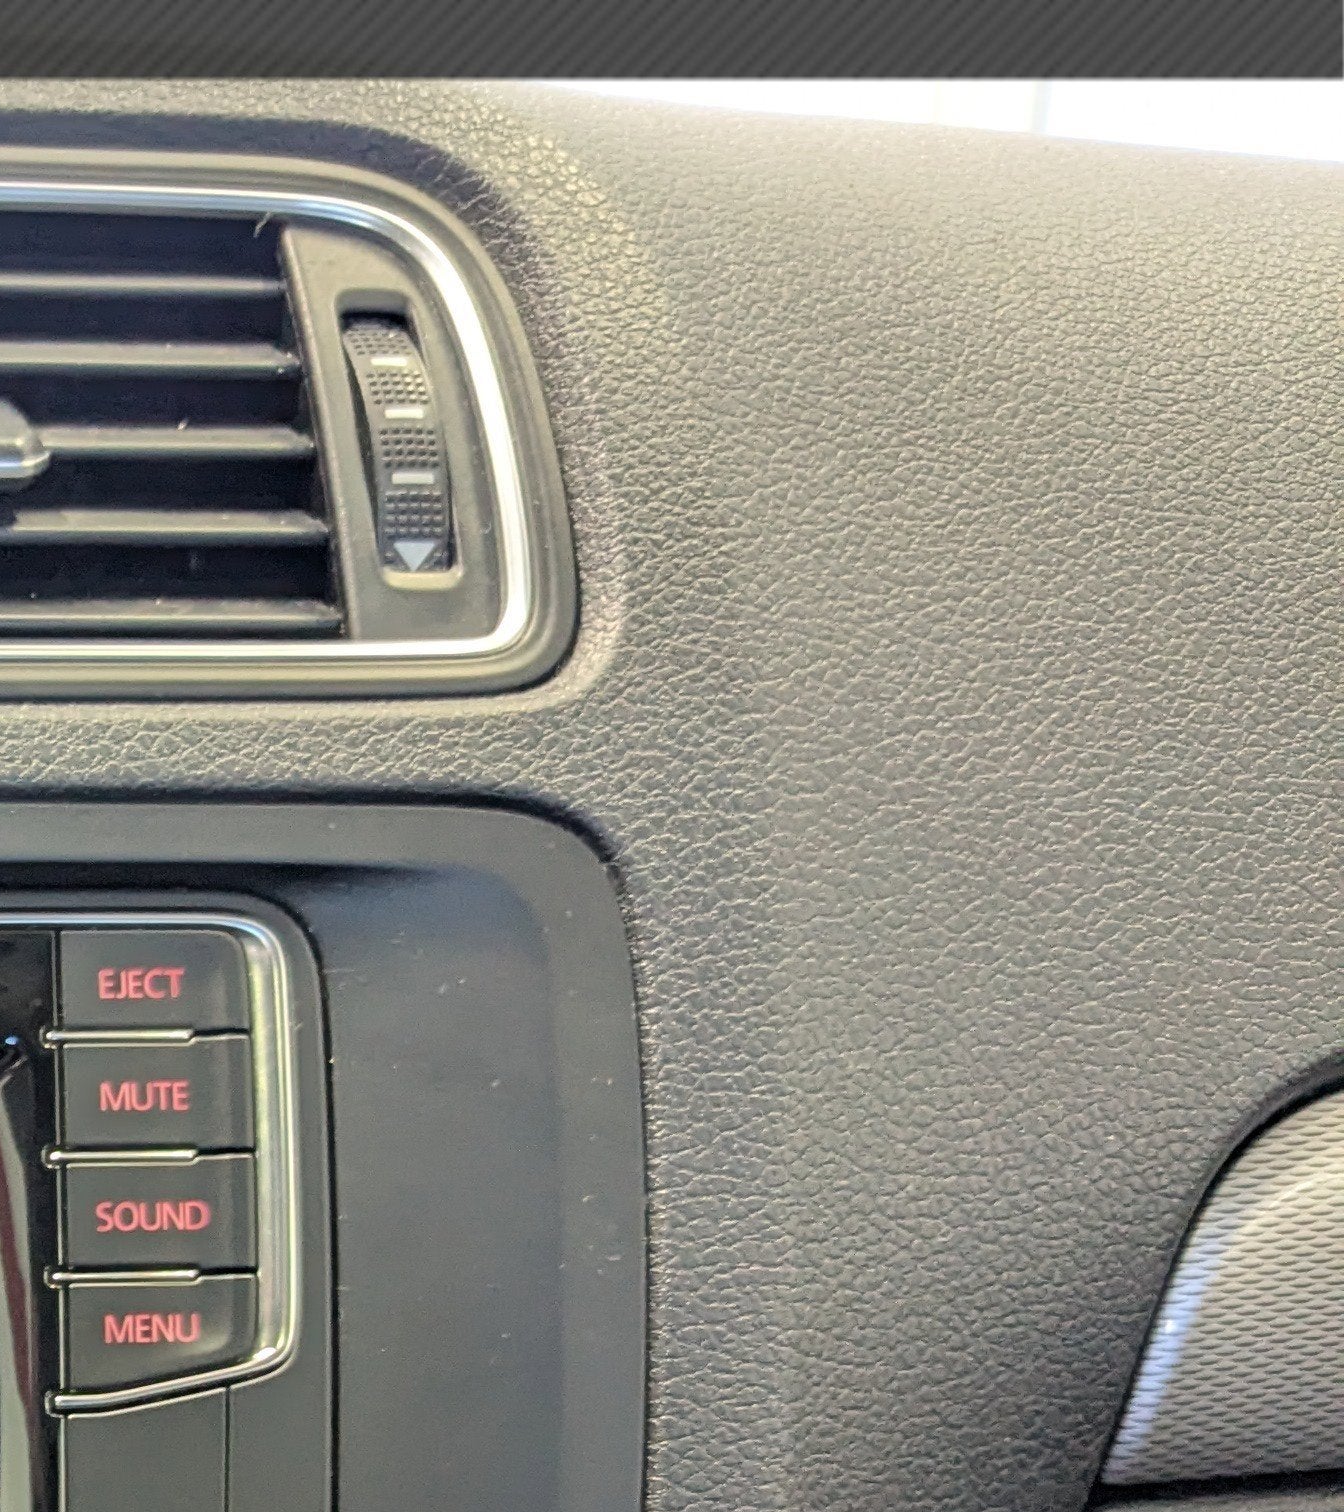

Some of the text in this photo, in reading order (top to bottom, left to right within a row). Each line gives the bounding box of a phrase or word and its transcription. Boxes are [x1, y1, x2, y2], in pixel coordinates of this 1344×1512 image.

[97, 966, 184, 1001] EJECT
[99, 1079, 189, 1113] MUTE
[95, 1199, 211, 1233] SOUND
[103, 1311, 201, 1345] MENU
